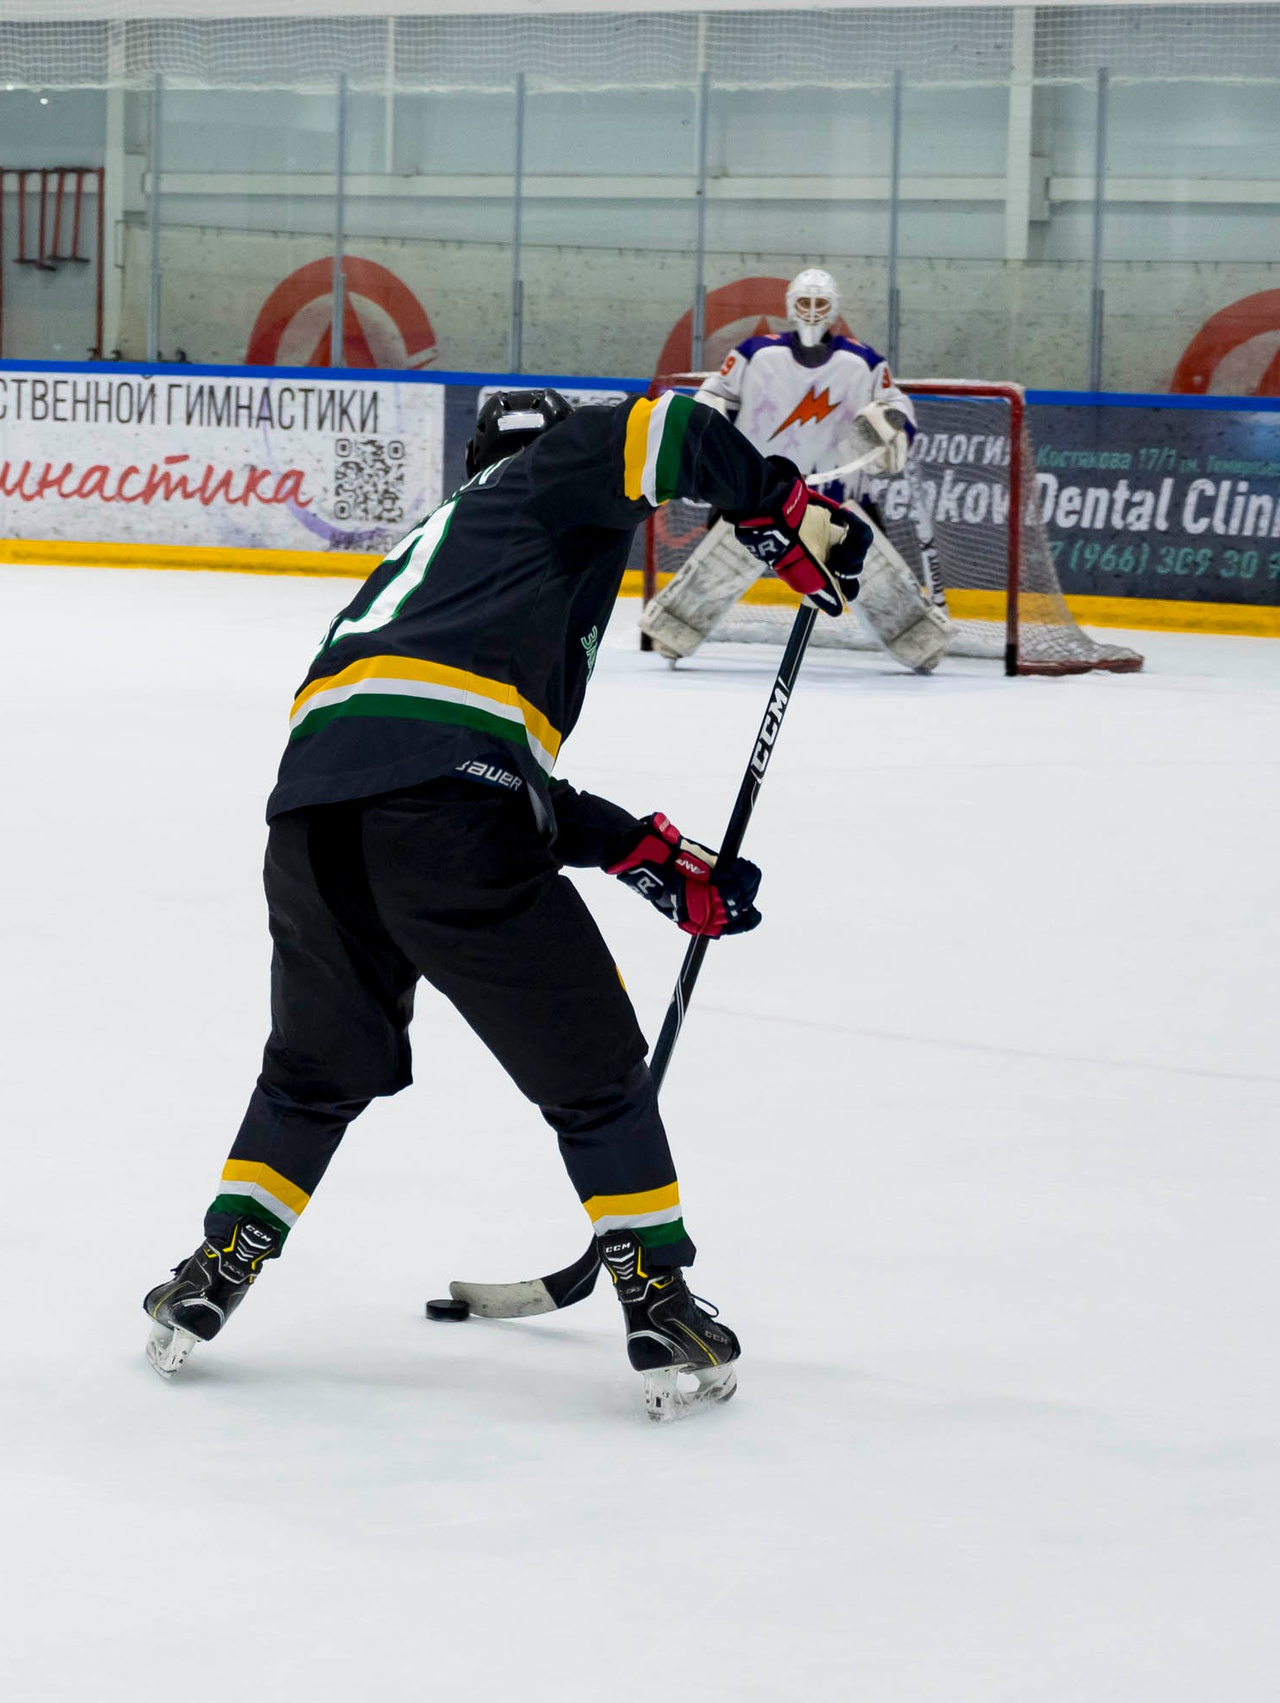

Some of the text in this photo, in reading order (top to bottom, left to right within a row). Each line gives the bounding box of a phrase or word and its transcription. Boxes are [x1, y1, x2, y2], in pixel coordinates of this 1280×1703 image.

[166, 382, 379, 434] ГИМНАСТИКИ
[1024, 472, 1174, 532] Dental
[1069, 539, 1150, 576] (966)
[1156, 546, 1213, 576] 309
[1220, 549, 1258, 578] 30
[750, 687, 789, 773] CCM
[244, 1223, 273, 1243] CCM
[605, 1241, 632, 1254] CCM
